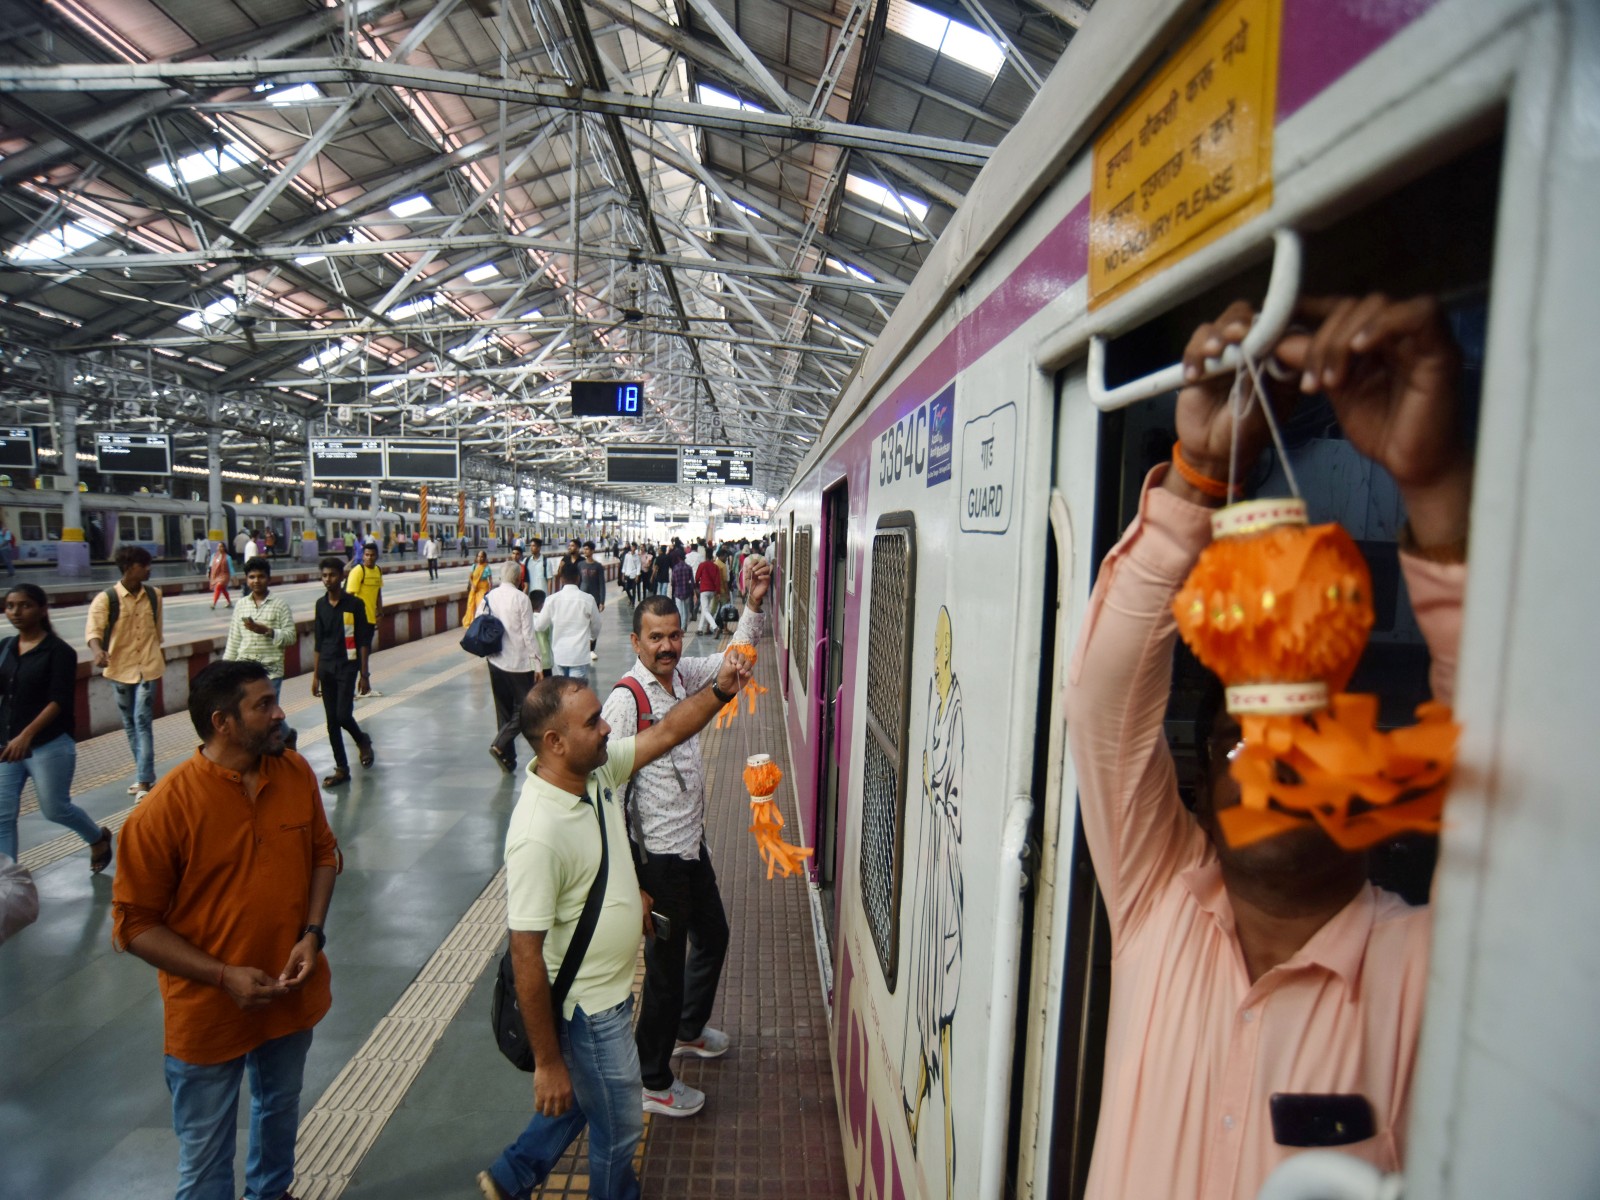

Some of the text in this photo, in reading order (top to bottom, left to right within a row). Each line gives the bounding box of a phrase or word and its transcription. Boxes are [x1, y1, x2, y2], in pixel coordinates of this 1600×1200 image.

[1103, 164, 1235, 276] NO ENQUIRY PLEASE
[617, 386, 638, 412] 18
[712, 416, 720, 427] 6
[879, 404, 927, 487] 5364C
[967, 485, 1003, 518] GUARD
